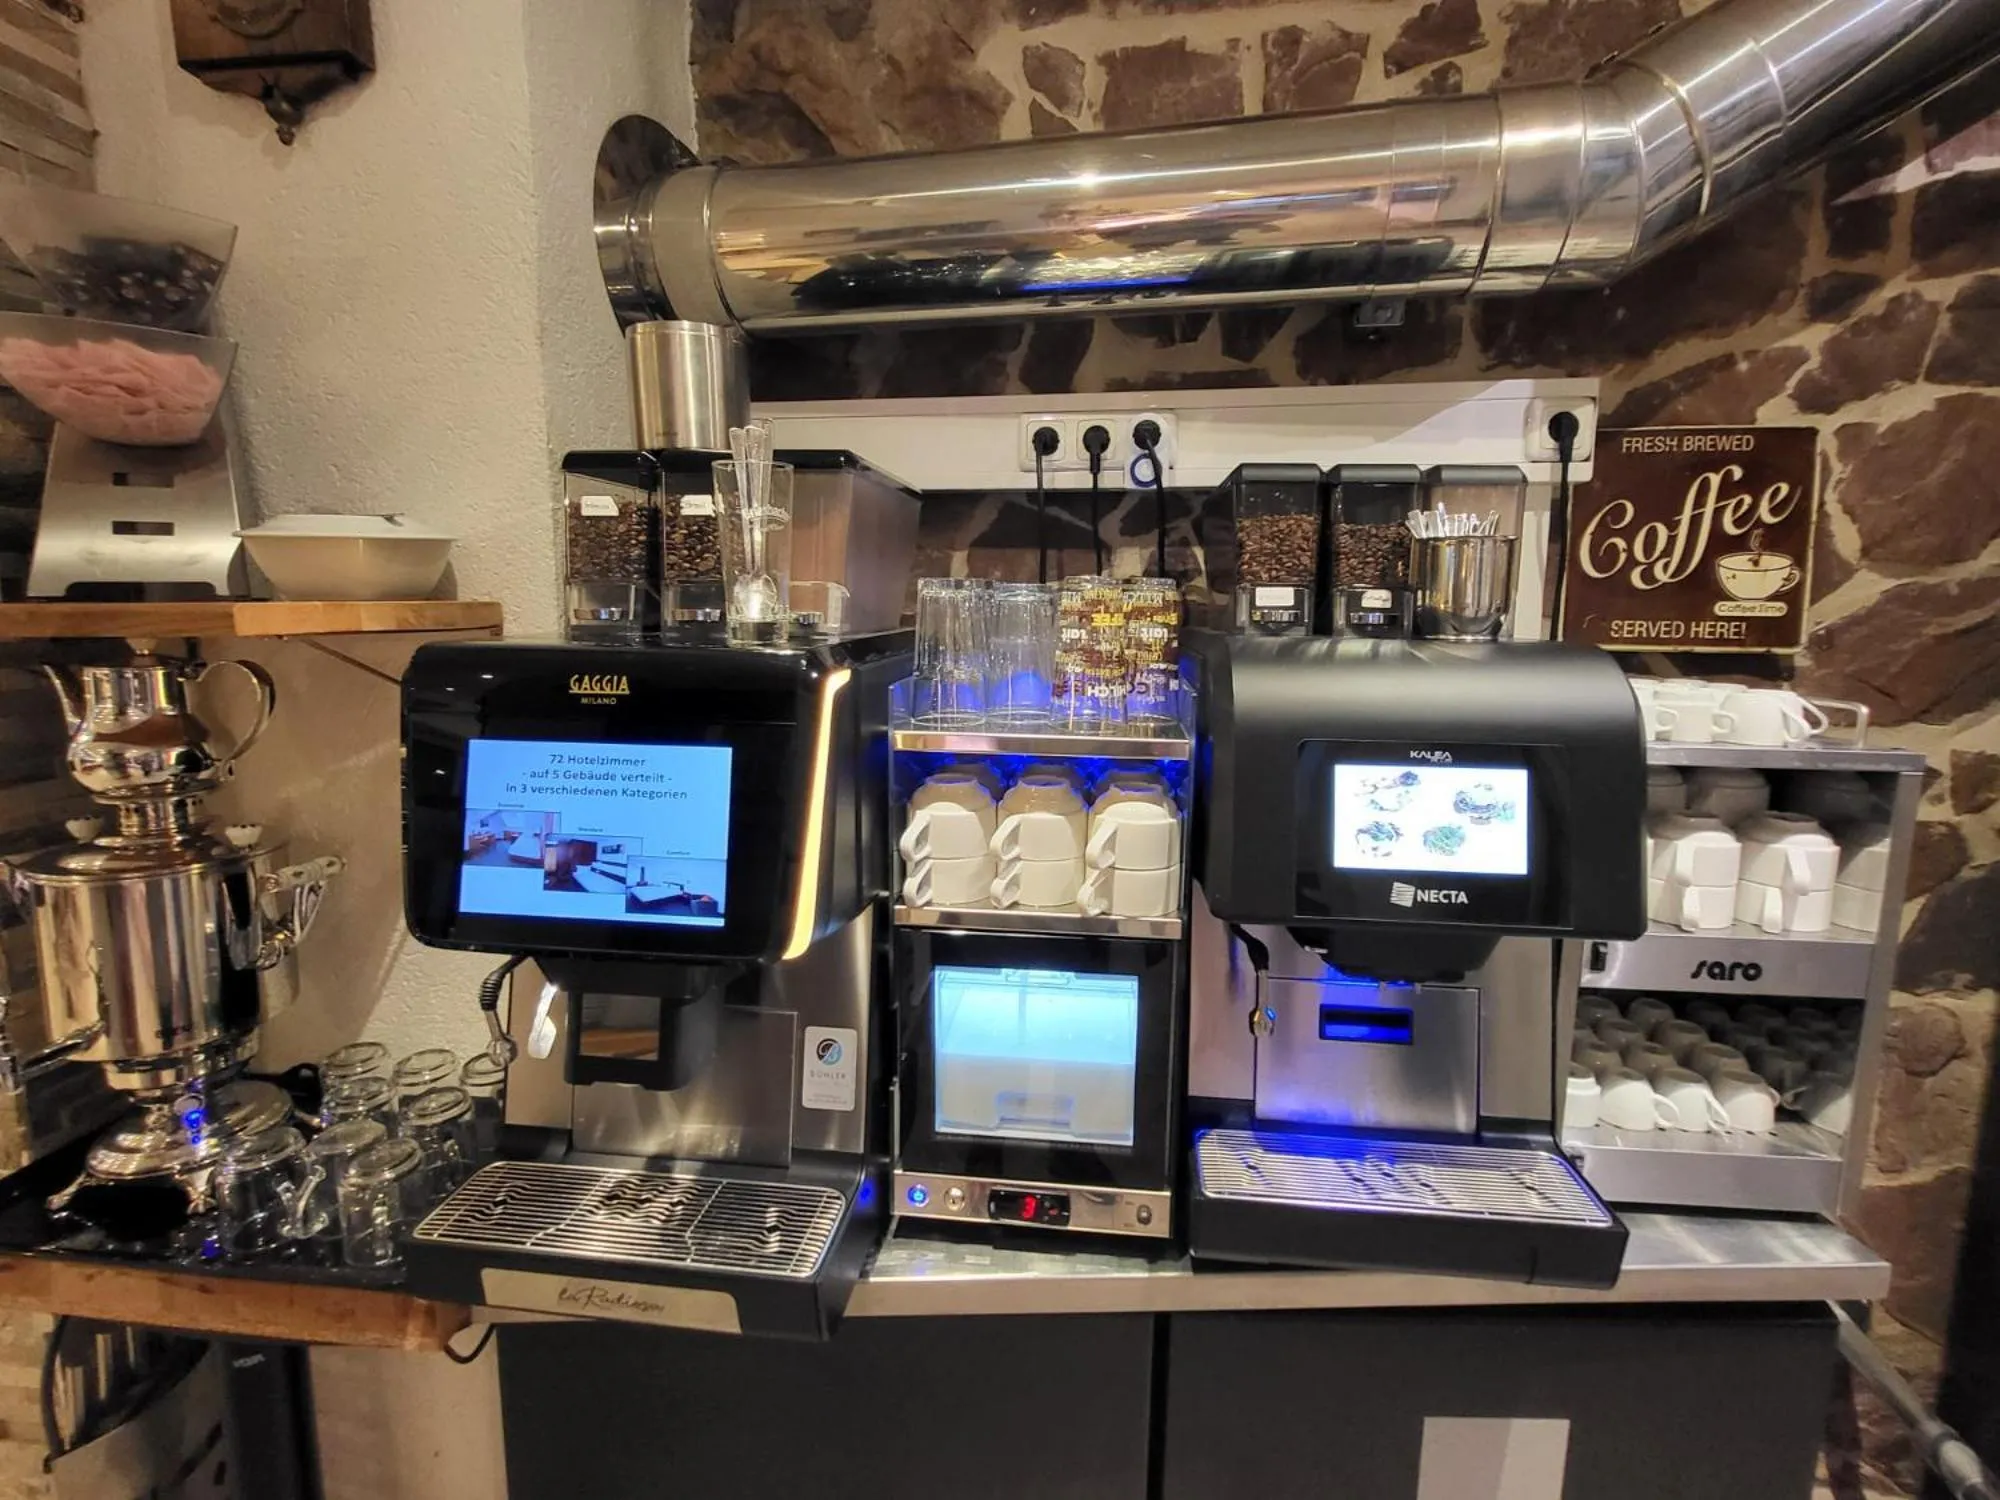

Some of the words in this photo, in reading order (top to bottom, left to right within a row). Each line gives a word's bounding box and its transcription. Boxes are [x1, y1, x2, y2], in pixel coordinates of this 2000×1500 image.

[1621, 436, 1678, 453] FRESH
[1683, 434, 1755, 452] BREWED
[1578, 463, 1803, 591] Coffee
[1610, 620, 1685, 639] SERVED
[1690, 621, 1747, 639] HERE!
[569, 674, 629, 691] GAGGIA
[580, 696, 617, 705] MILANO
[549, 754, 564, 764] 72
[567, 755, 646, 767] Hotelzimmer
[529, 769, 549, 779] auf
[552, 770, 560, 779] 5
[563, 770, 616, 781] Gebäude
[620, 772, 665, 783] verteilt
[506, 783, 517, 793] in
[520, 784, 527, 793] 3
[530, 785, 618, 797] verschiedenen
[621, 787, 688, 801] Kategorien
[1417, 888, 1469, 904] NECTA
[1690, 960, 1763, 982] saro
